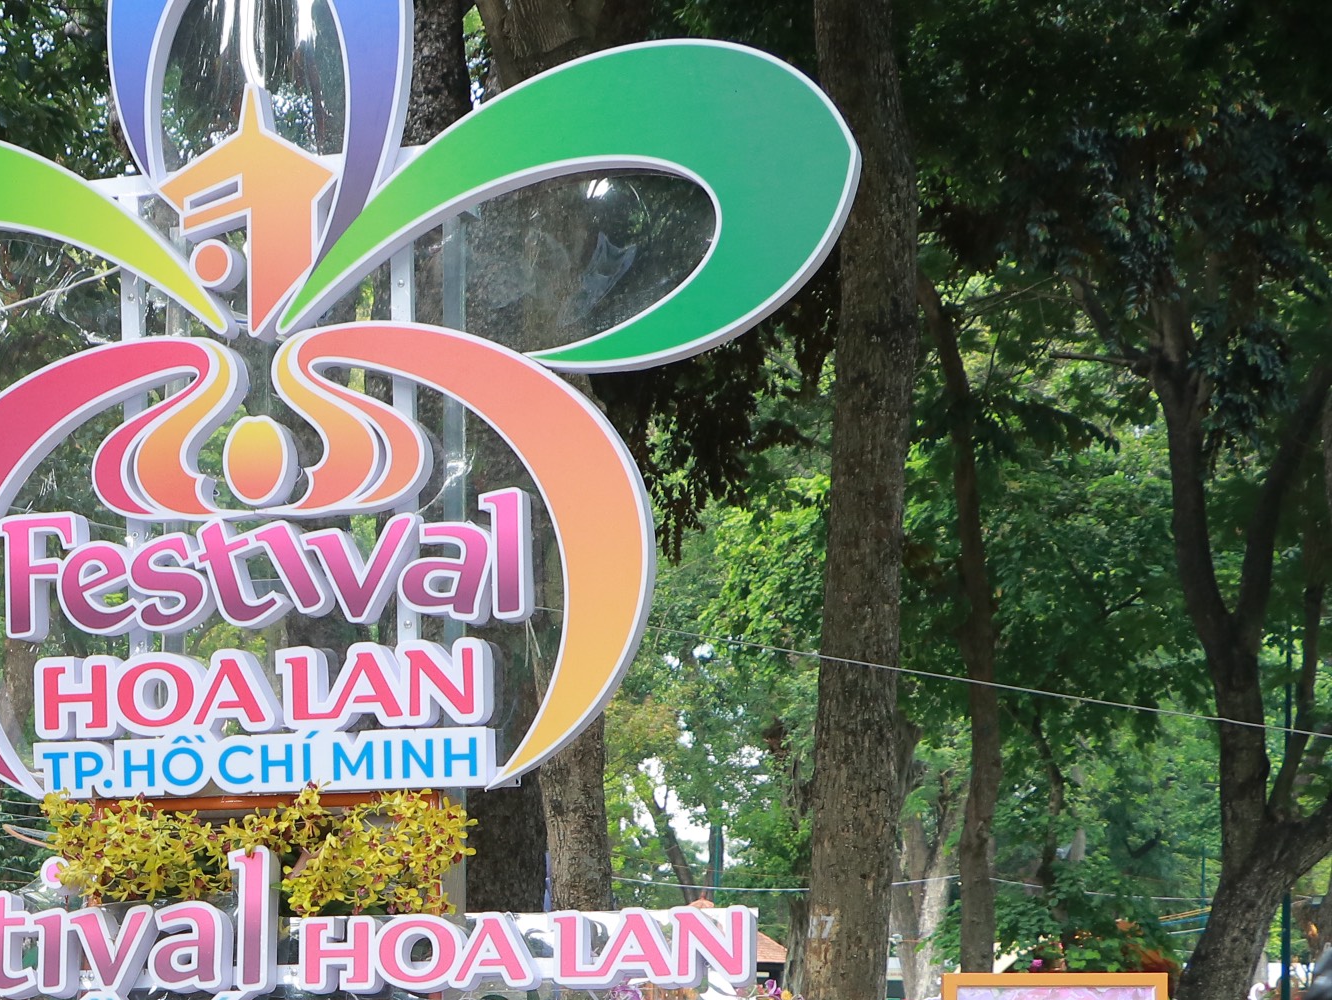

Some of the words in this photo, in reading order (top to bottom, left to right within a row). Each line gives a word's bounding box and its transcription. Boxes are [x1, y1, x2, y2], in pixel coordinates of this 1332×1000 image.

[1, 490, 522, 635] Festival
[42, 657, 266, 731] HOA
[283, 646, 475, 721] LAN
[217, 730, 313, 786] CHÍ
[332, 736, 479, 783] MINH
[304, 917, 528, 984] HOA
[553, 911, 744, 978] LAN
